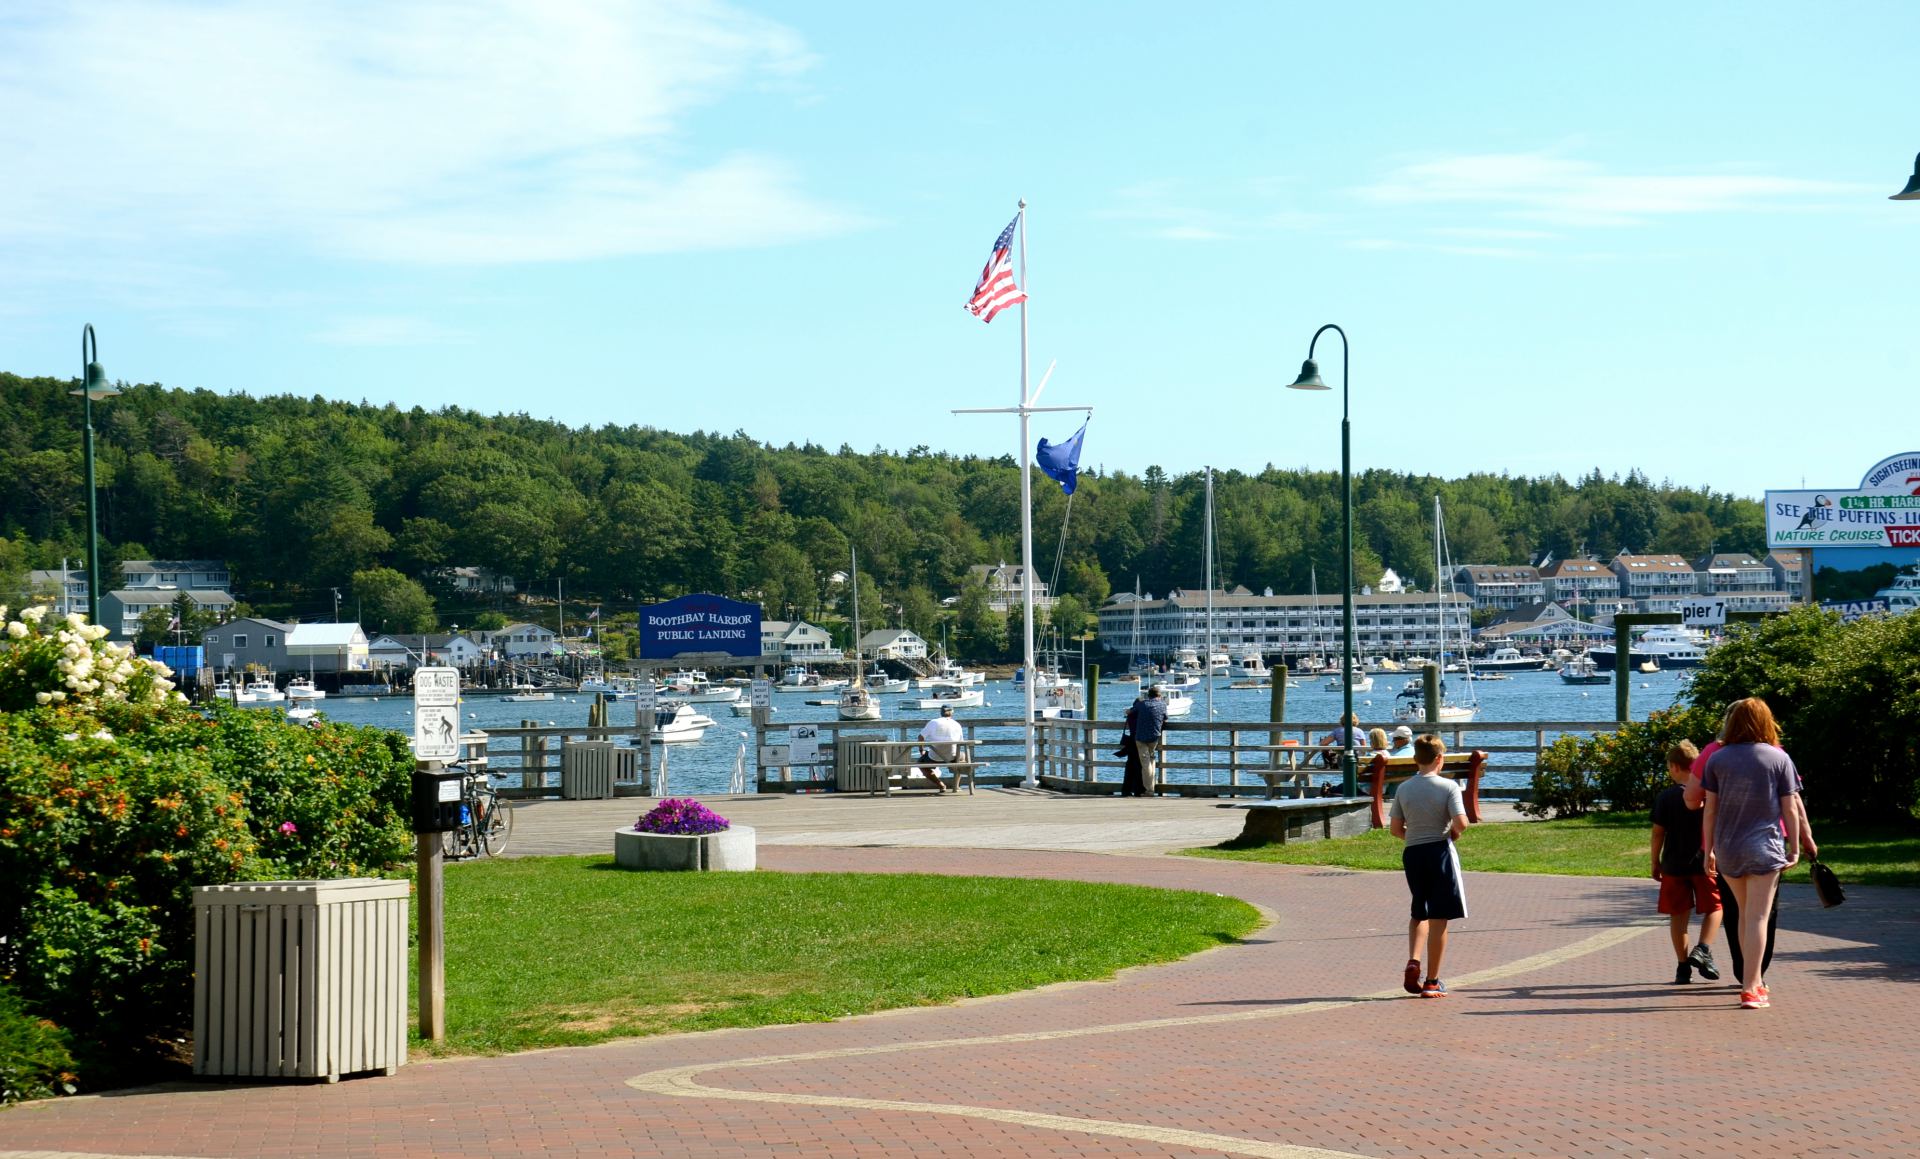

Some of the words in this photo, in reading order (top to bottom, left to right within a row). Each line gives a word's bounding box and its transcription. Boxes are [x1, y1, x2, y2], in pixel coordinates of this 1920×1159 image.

[1869, 458, 1920, 487] SIGHTSEEIN
[1776, 503, 1801, 518] SEE
[1806, 506, 1834, 521] THE
[1839, 509, 1896, 524] PUFFINS
[1905, 511, 1920, 524] LI
[1775, 530, 1826, 542] NATURE
[1829, 529, 1885, 541] CRUISES
[1890, 530, 1920, 544] TICK
[649, 613, 705, 626] BOOTHBAY
[709, 613, 752, 625] HARBOR
[1683, 602, 1712, 622] pier
[1715, 602, 1724, 617] 7
[658, 631, 695, 640] PUBLIC
[699, 630, 746, 640] LANDING
[420, 676, 431, 687] DOG
[434, 676, 454, 687] WASTE
